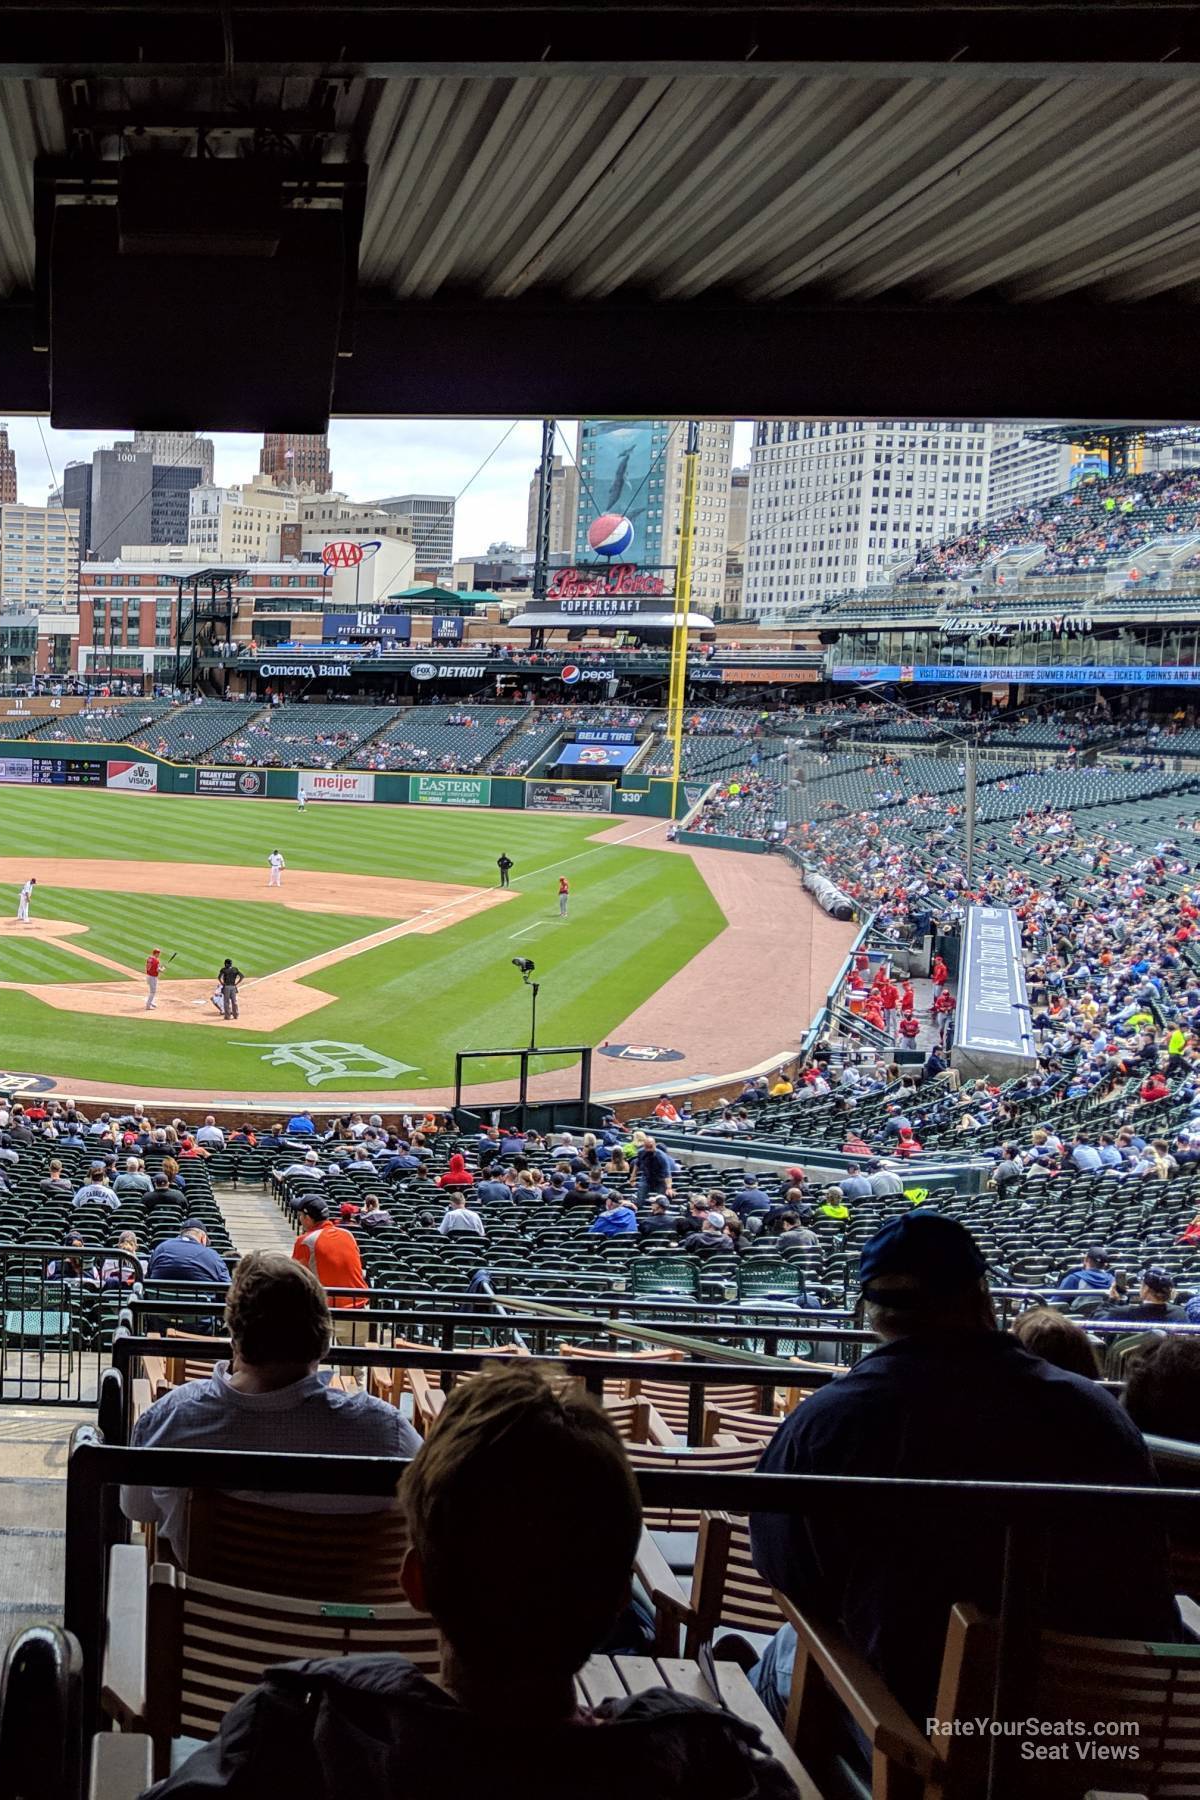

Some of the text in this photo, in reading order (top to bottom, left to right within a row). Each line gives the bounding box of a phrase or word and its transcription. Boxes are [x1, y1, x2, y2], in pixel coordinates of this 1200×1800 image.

[117, 453, 137, 463] 1001
[324, 543, 362, 567] AAA
[561, 600, 641, 611] COPPERCRAFT
[357, 611, 380, 627] Lite
[1018, 618, 1051, 632] TIGER
[1063, 618, 1093, 631] CLUB
[338, 627, 396, 635] PITCHER'S PUB
[319, 664, 351, 676] Bank
[438, 666, 487, 678] DETROIT
[581, 669, 614, 680] pepsi
[920, 669, 934, 679] VISIT
[970, 670, 982, 679] FOR
[983, 670, 988, 679] A
[989, 670, 1015, 679] SPECIAL
[1036, 670, 1064, 680] SUMMER
[1065, 670, 1087, 680] PARTY
[1088, 670, 1105, 680] PACK
[1145, 671, 1172, 680] DRINKS
[1173, 671, 1188, 680] AND
[15, 700, 23, 708] 11
[50, 699, 61, 708] 42
[578, 732, 633, 741] BELLE TIRE
[200, 771, 221, 779] FREAKY
[128, 777, 154, 786] VISION
[313, 774, 358, 791] meijer
[419, 777, 481, 792] EASTERN
